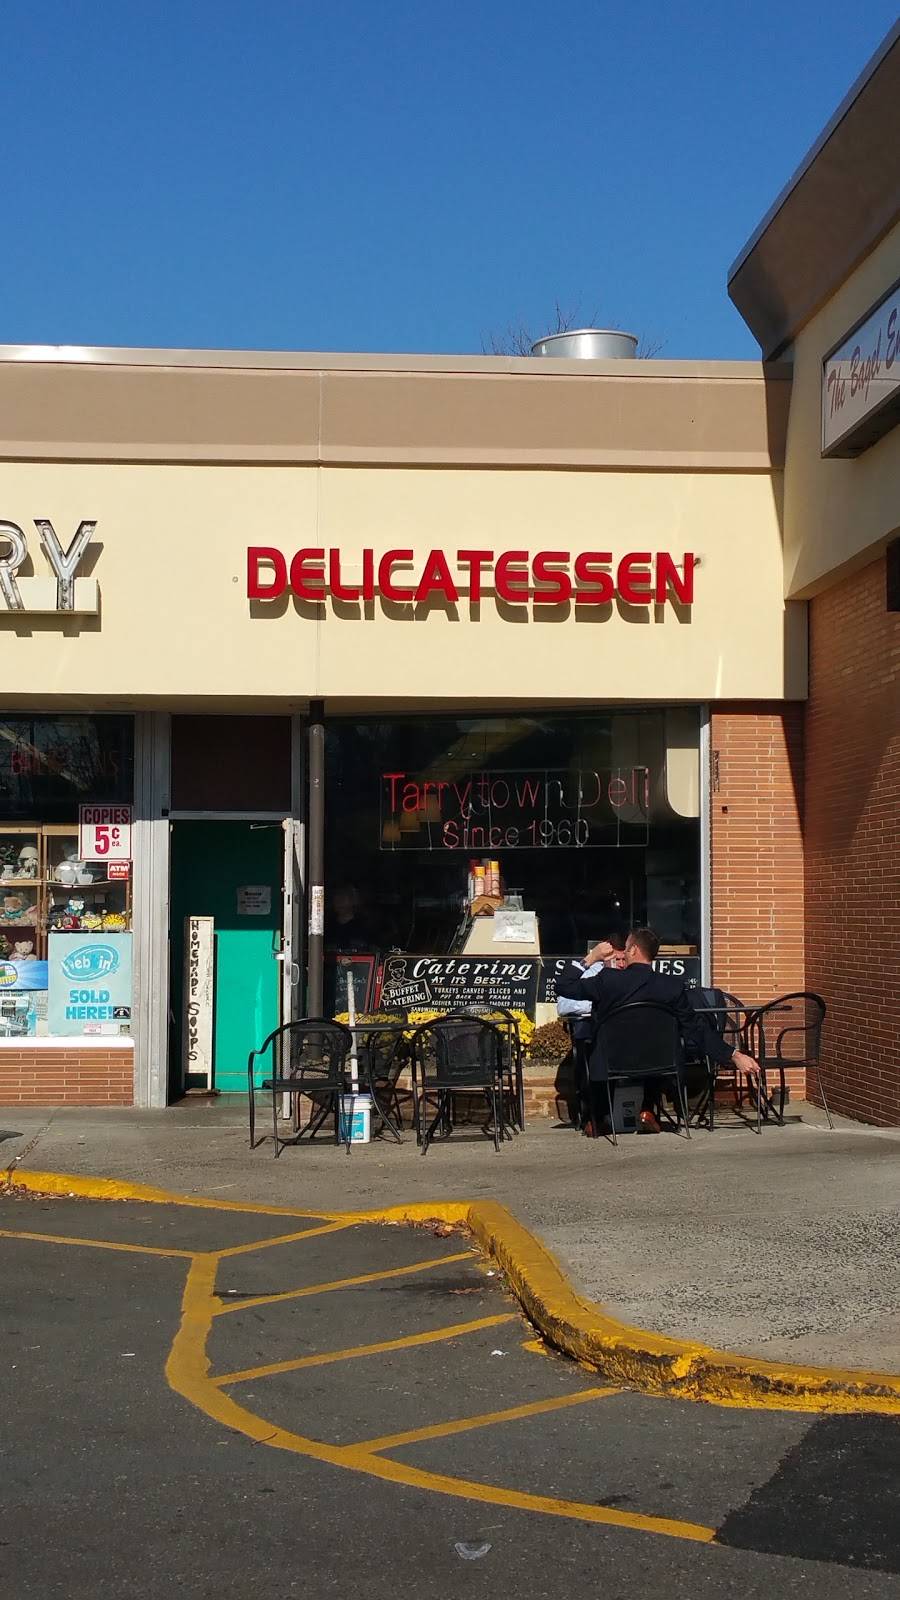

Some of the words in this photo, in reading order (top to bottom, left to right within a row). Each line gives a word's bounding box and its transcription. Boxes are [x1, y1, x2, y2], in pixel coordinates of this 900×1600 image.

[827, 366, 846, 419] The
[850, 328, 881, 402] Bagel
[247, 546, 694, 604] DELICATESSEN
[84, 808, 129, 824] COPIES
[442, 819, 519, 848] Since
[527, 818, 590, 848] 1960
[190, 920, 200, 996] HOMEMADE
[412, 958, 533, 982] Catering
[431, 976, 445, 984] AT
[69, 989, 110, 1004] SOLD
[386, 992, 427, 1006] CATERING
[389, 983, 420, 999] BUFFET
[513, 987, 527, 995] AND
[65, 1005, 113, 1020] HERE!
[188, 1002, 200, 1061] SOUPS
